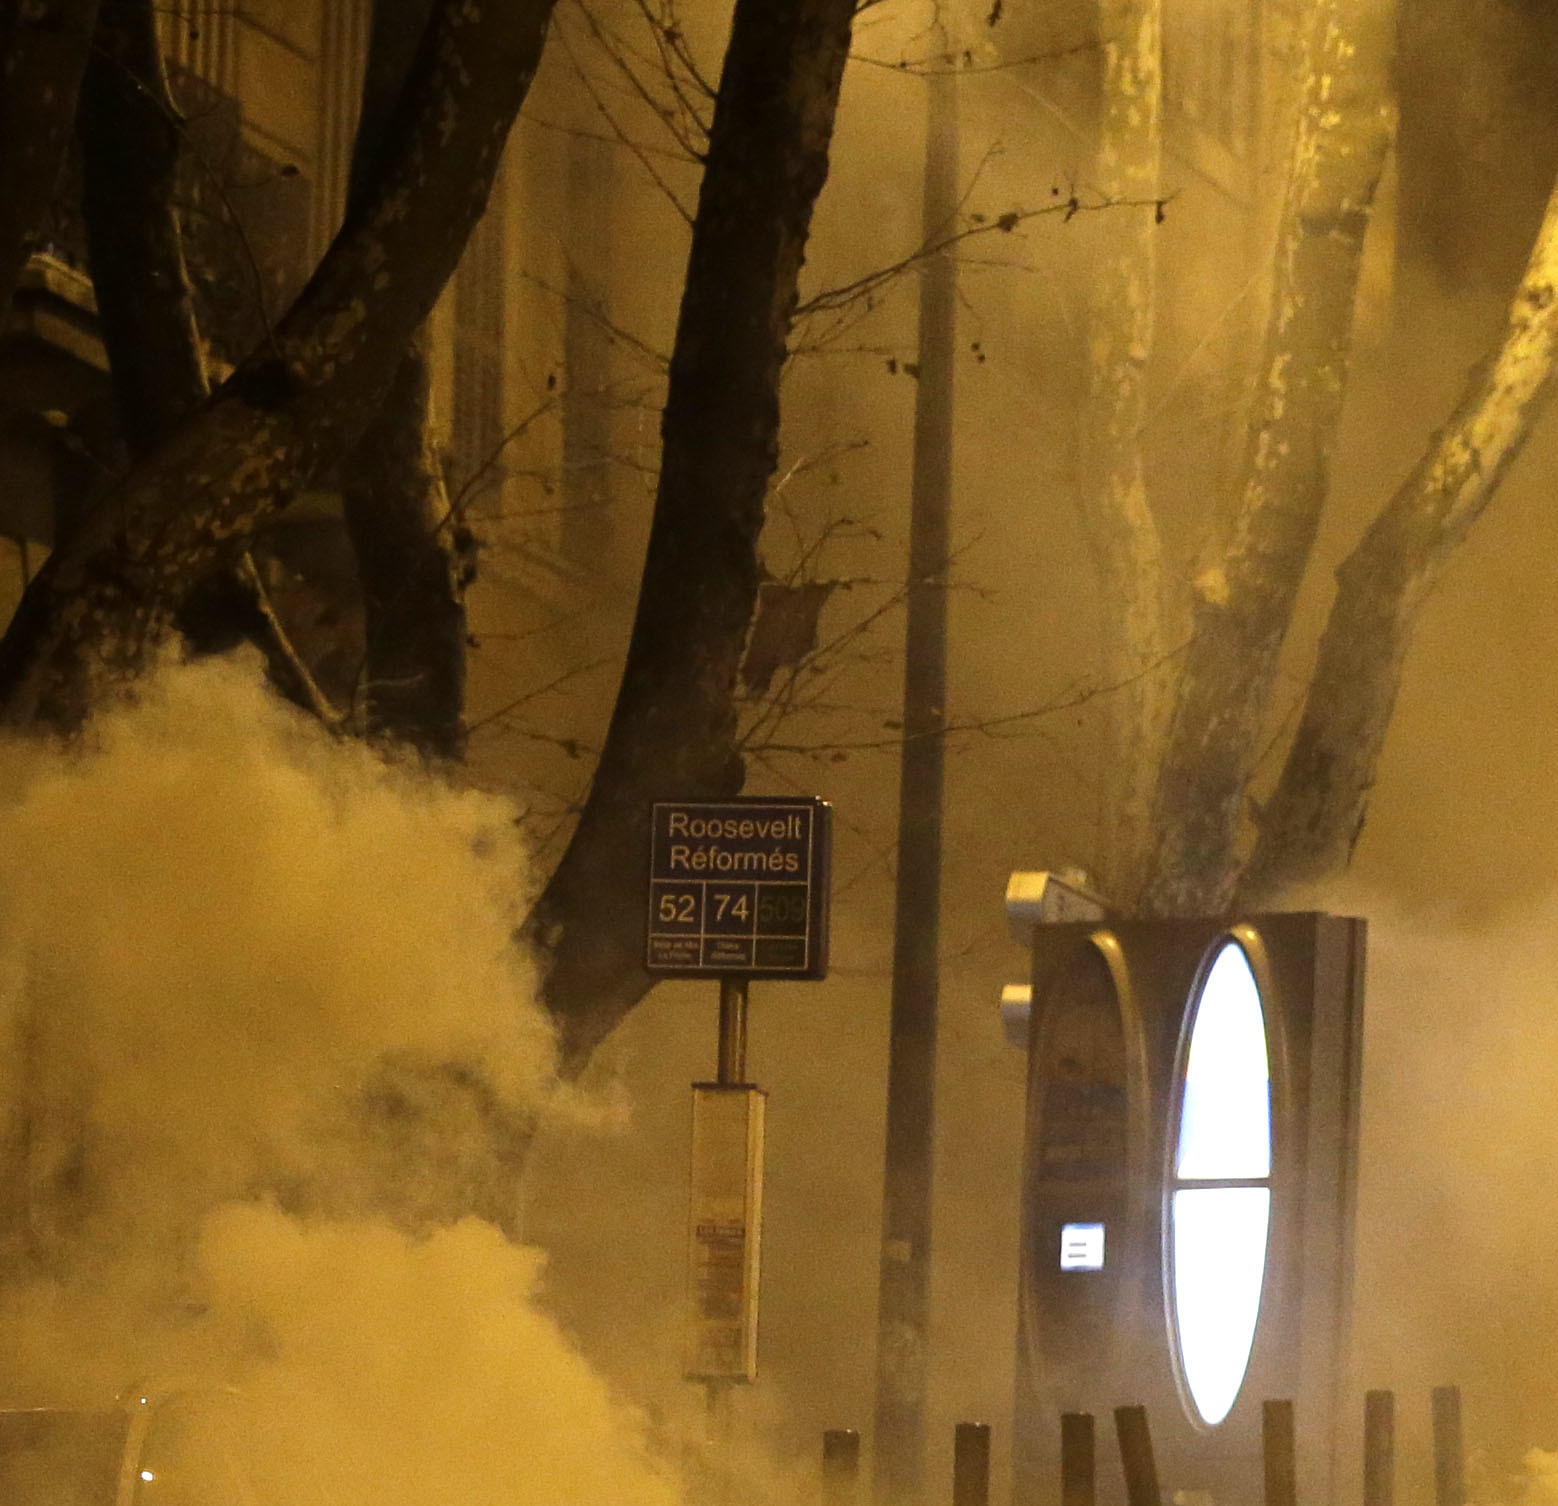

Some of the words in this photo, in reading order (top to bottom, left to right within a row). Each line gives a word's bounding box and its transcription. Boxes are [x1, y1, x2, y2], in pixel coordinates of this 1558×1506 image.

[668, 812, 801, 840] Roosevelt
[669, 844, 799, 872] Réformés
[658, 894, 696, 923] 52
[713, 894, 750, 923] 74
